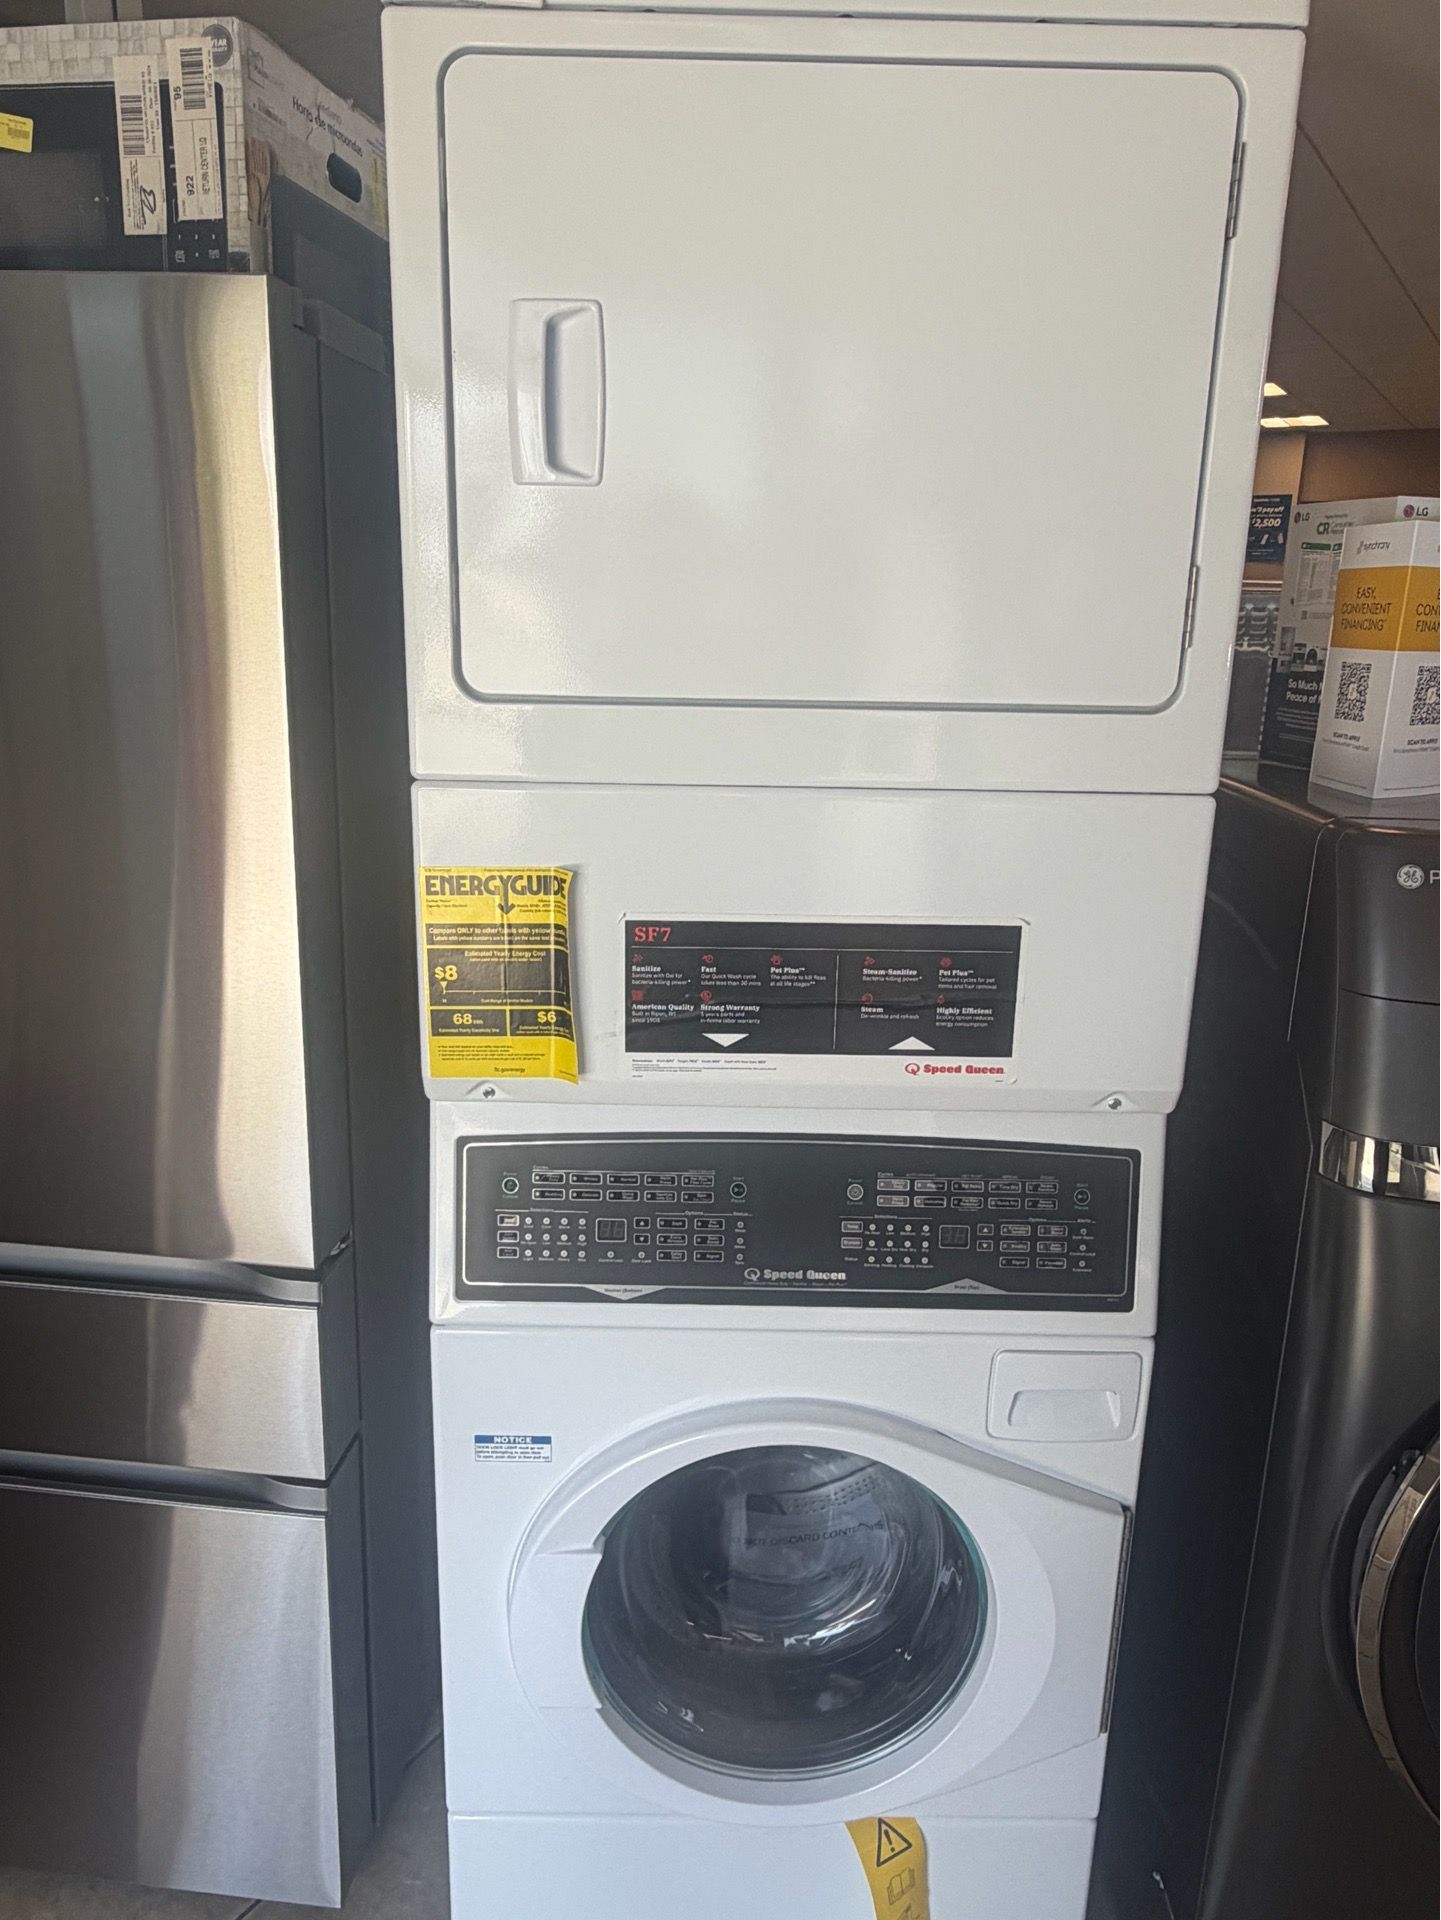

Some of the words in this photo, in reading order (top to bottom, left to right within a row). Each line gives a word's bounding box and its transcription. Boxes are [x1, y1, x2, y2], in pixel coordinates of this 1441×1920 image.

[173, 86, 182, 100] 95
[292, 97, 313, 122] Horno
[315, 106, 326, 130] de
[185, 176, 195, 196] 922
[1302, 512, 1310, 521] LG
[1416, 507, 1429, 516] LG
[1317, 523, 1329, 534] CR
[1341, 602, 1392, 615] CONVENIENT
[1288, 679, 1296, 689] So
[1299, 680, 1318, 690] Much
[1286, 692, 1308, 703] Peace
[425, 874, 567, 900] ENERGYGUIDE
[429, 927, 457, 935] Compare
[634, 927, 671, 942] SF7
[434, 965, 458, 981] $8
[668, 1004, 694, 1012] Quality
[726, 1005, 760, 1013] Warranty
[453, 1013, 472, 1025] 68
[537, 1011, 557, 1023] $6
[923, 1064, 961, 1075] Speed
[965, 1065, 1004, 1075] Queen
[763, 1269, 803, 1280] Speed
[806, 1270, 846, 1280] Queen
[493, 1436, 533, 1444] NOTICE
